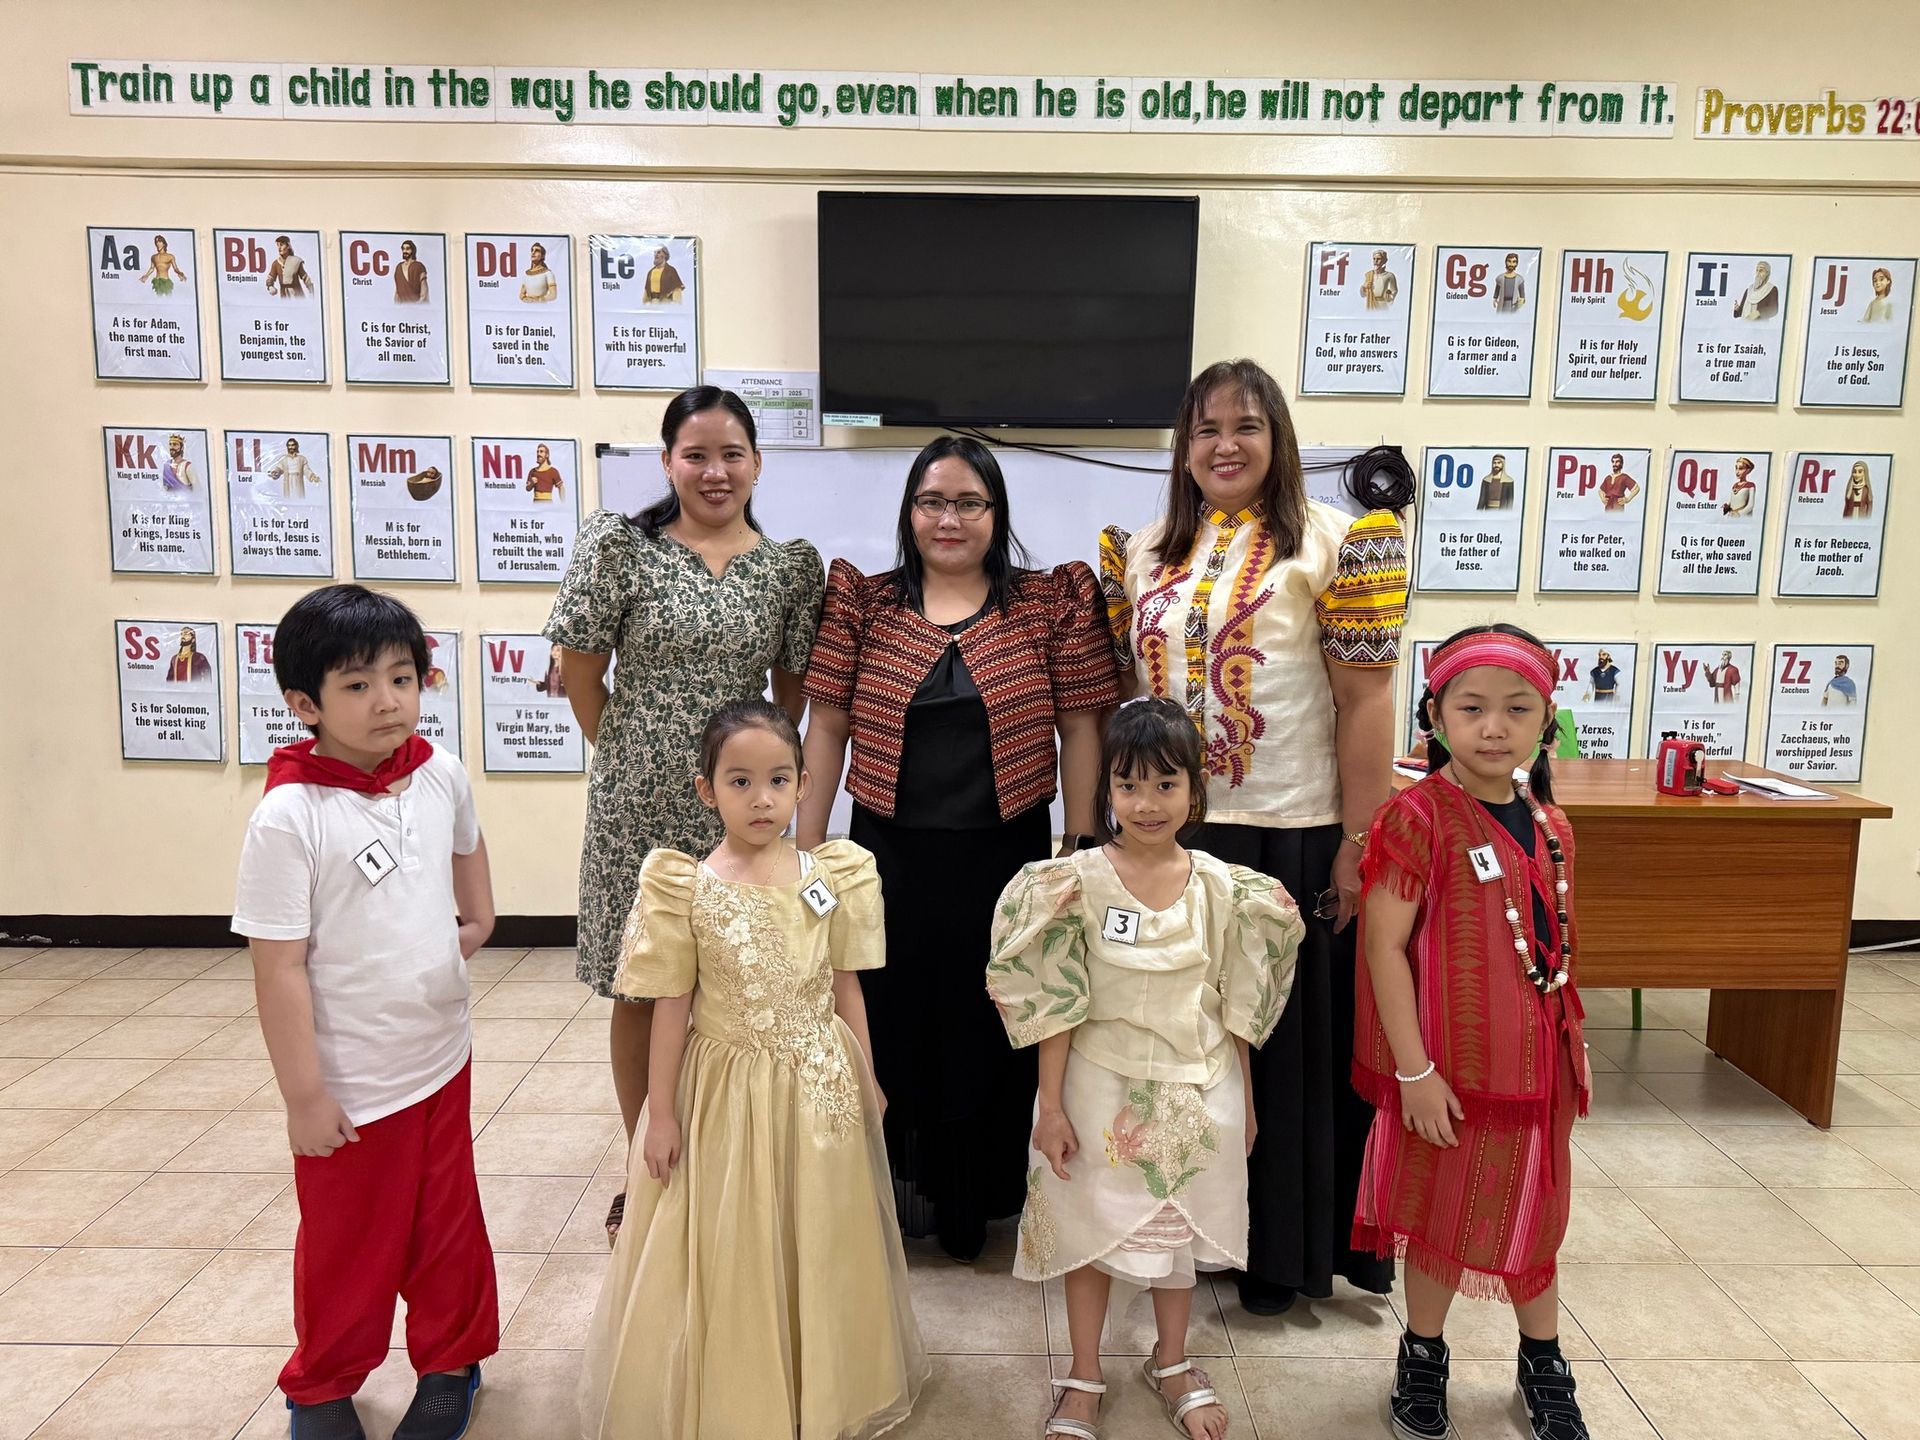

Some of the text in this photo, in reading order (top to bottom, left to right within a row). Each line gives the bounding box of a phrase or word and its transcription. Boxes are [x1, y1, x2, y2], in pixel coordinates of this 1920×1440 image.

[71, 63, 173, 106] Train
[190, 73, 233, 112] up
[250, 74, 269, 104] a
[289, 67, 370, 106] child
[385, 67, 414, 105] in
[427, 69, 489, 107] the
[511, 77, 573, 122] way
[589, 70, 630, 109] he
[645, 71, 760, 113] should
[935, 78, 1017, 116] when
[1036, 79, 1077, 117] he
[1097, 79, 1126, 118] is
[1261, 80, 1309, 119] will
[1323, 83, 1385, 121] not
[1400, 83, 1524, 129] depart
[1538, 82, 1623, 122] from
[1641, 84, 1673, 123] it.
[1703, 89, 1866, 134] Proverbs
[101, 235, 140, 271] Aa
[224, 237, 266, 273] Bb
[350, 240, 389, 276] Cc
[476, 242, 517, 278] Dd
[600, 244, 635, 279] Ee
[1319, 251, 1349, 285] Ff
[227, 274, 258, 283] Benjamin
[352, 277, 372, 286] Christ
[1446, 254, 1489, 299] Gg
[1571, 258, 1613, 293] Hh
[1695, 262, 1728, 297] Ii
[479, 280, 499, 288] Daniel
[602, 282, 620, 291] Elijah
[1822, 265, 1848, 307] Jj
[1320, 288, 1340, 296] Father
[1446, 292, 1468, 300] Gideon
[1571, 296, 1605, 305] Holy Spirit
[1820, 307, 1838, 315] Jesus
[113, 317, 180, 331] A is for Adam,
[254, 320, 289, 331] B is for
[109, 331, 185, 344] the name of the
[613, 326, 678, 340] E is for Elijah,
[240, 334, 305, 347] Benjamin, the
[1448, 336, 1519, 349] G is for Gideon,
[124, 346, 171, 358] first man.
[605, 341, 686, 354] with his powerful
[1834, 346, 1879, 358] J is Jesus,
[241, 350, 306, 362] youngest son.
[1457, 350, 1489, 361] farmer
[1491, 351, 1508, 361] and
[627, 358, 665, 368] prayers.
[1827, 360, 1884, 373] the only Son
[1464, 365, 1498, 375] soldier.
[741, 378, 783, 386] ATTENDANCE
[1838, 374, 1870, 385] of God.
[114, 435, 157, 469] Kk
[235, 438, 261, 472] Ll
[358, 443, 416, 474] Mm
[482, 445, 522, 479] Nn
[117, 471, 132, 480] King
[141, 472, 159, 481] kings
[1433, 454, 1474, 488] Oo
[1557, 455, 1597, 496] Pp
[1799, 460, 1836, 493] Rr
[361, 479, 386, 487] Messiah
[1678, 459, 1718, 500] Qq
[1676, 501, 1696, 509] Queen
[511, 519, 544, 529] N is for
[493, 532, 563, 545] Nehemiah, who
[493, 546, 564, 557] rebuilt the wall
[498, 560, 560, 571] of Jerusalem.
[125, 627, 160, 660] Ss
[488, 640, 524, 673] Vv
[127, 662, 154, 670] Solomon
[247, 666, 271, 674] Thomas
[1663, 651, 1698, 688] Yy
[1780, 652, 1812, 684] Zz
[491, 675, 527, 684] Virgin Mary
[132, 703, 209, 716] S is for Solomon,
[135, 716, 206, 730] the wisest king
[1802, 721, 1833, 731] Z is for
[158, 730, 184, 740] of all.
[1781, 734, 1850, 745] Zacchaeus, who
[1776, 747, 1853, 759] worshipped Jesus
[1789, 760, 1837, 770] our Savior.
[366, 852, 381, 870] 1
[1474, 851, 1490, 872] 4
[810, 889, 828, 907] 2
[1114, 914, 1129, 934] 3
